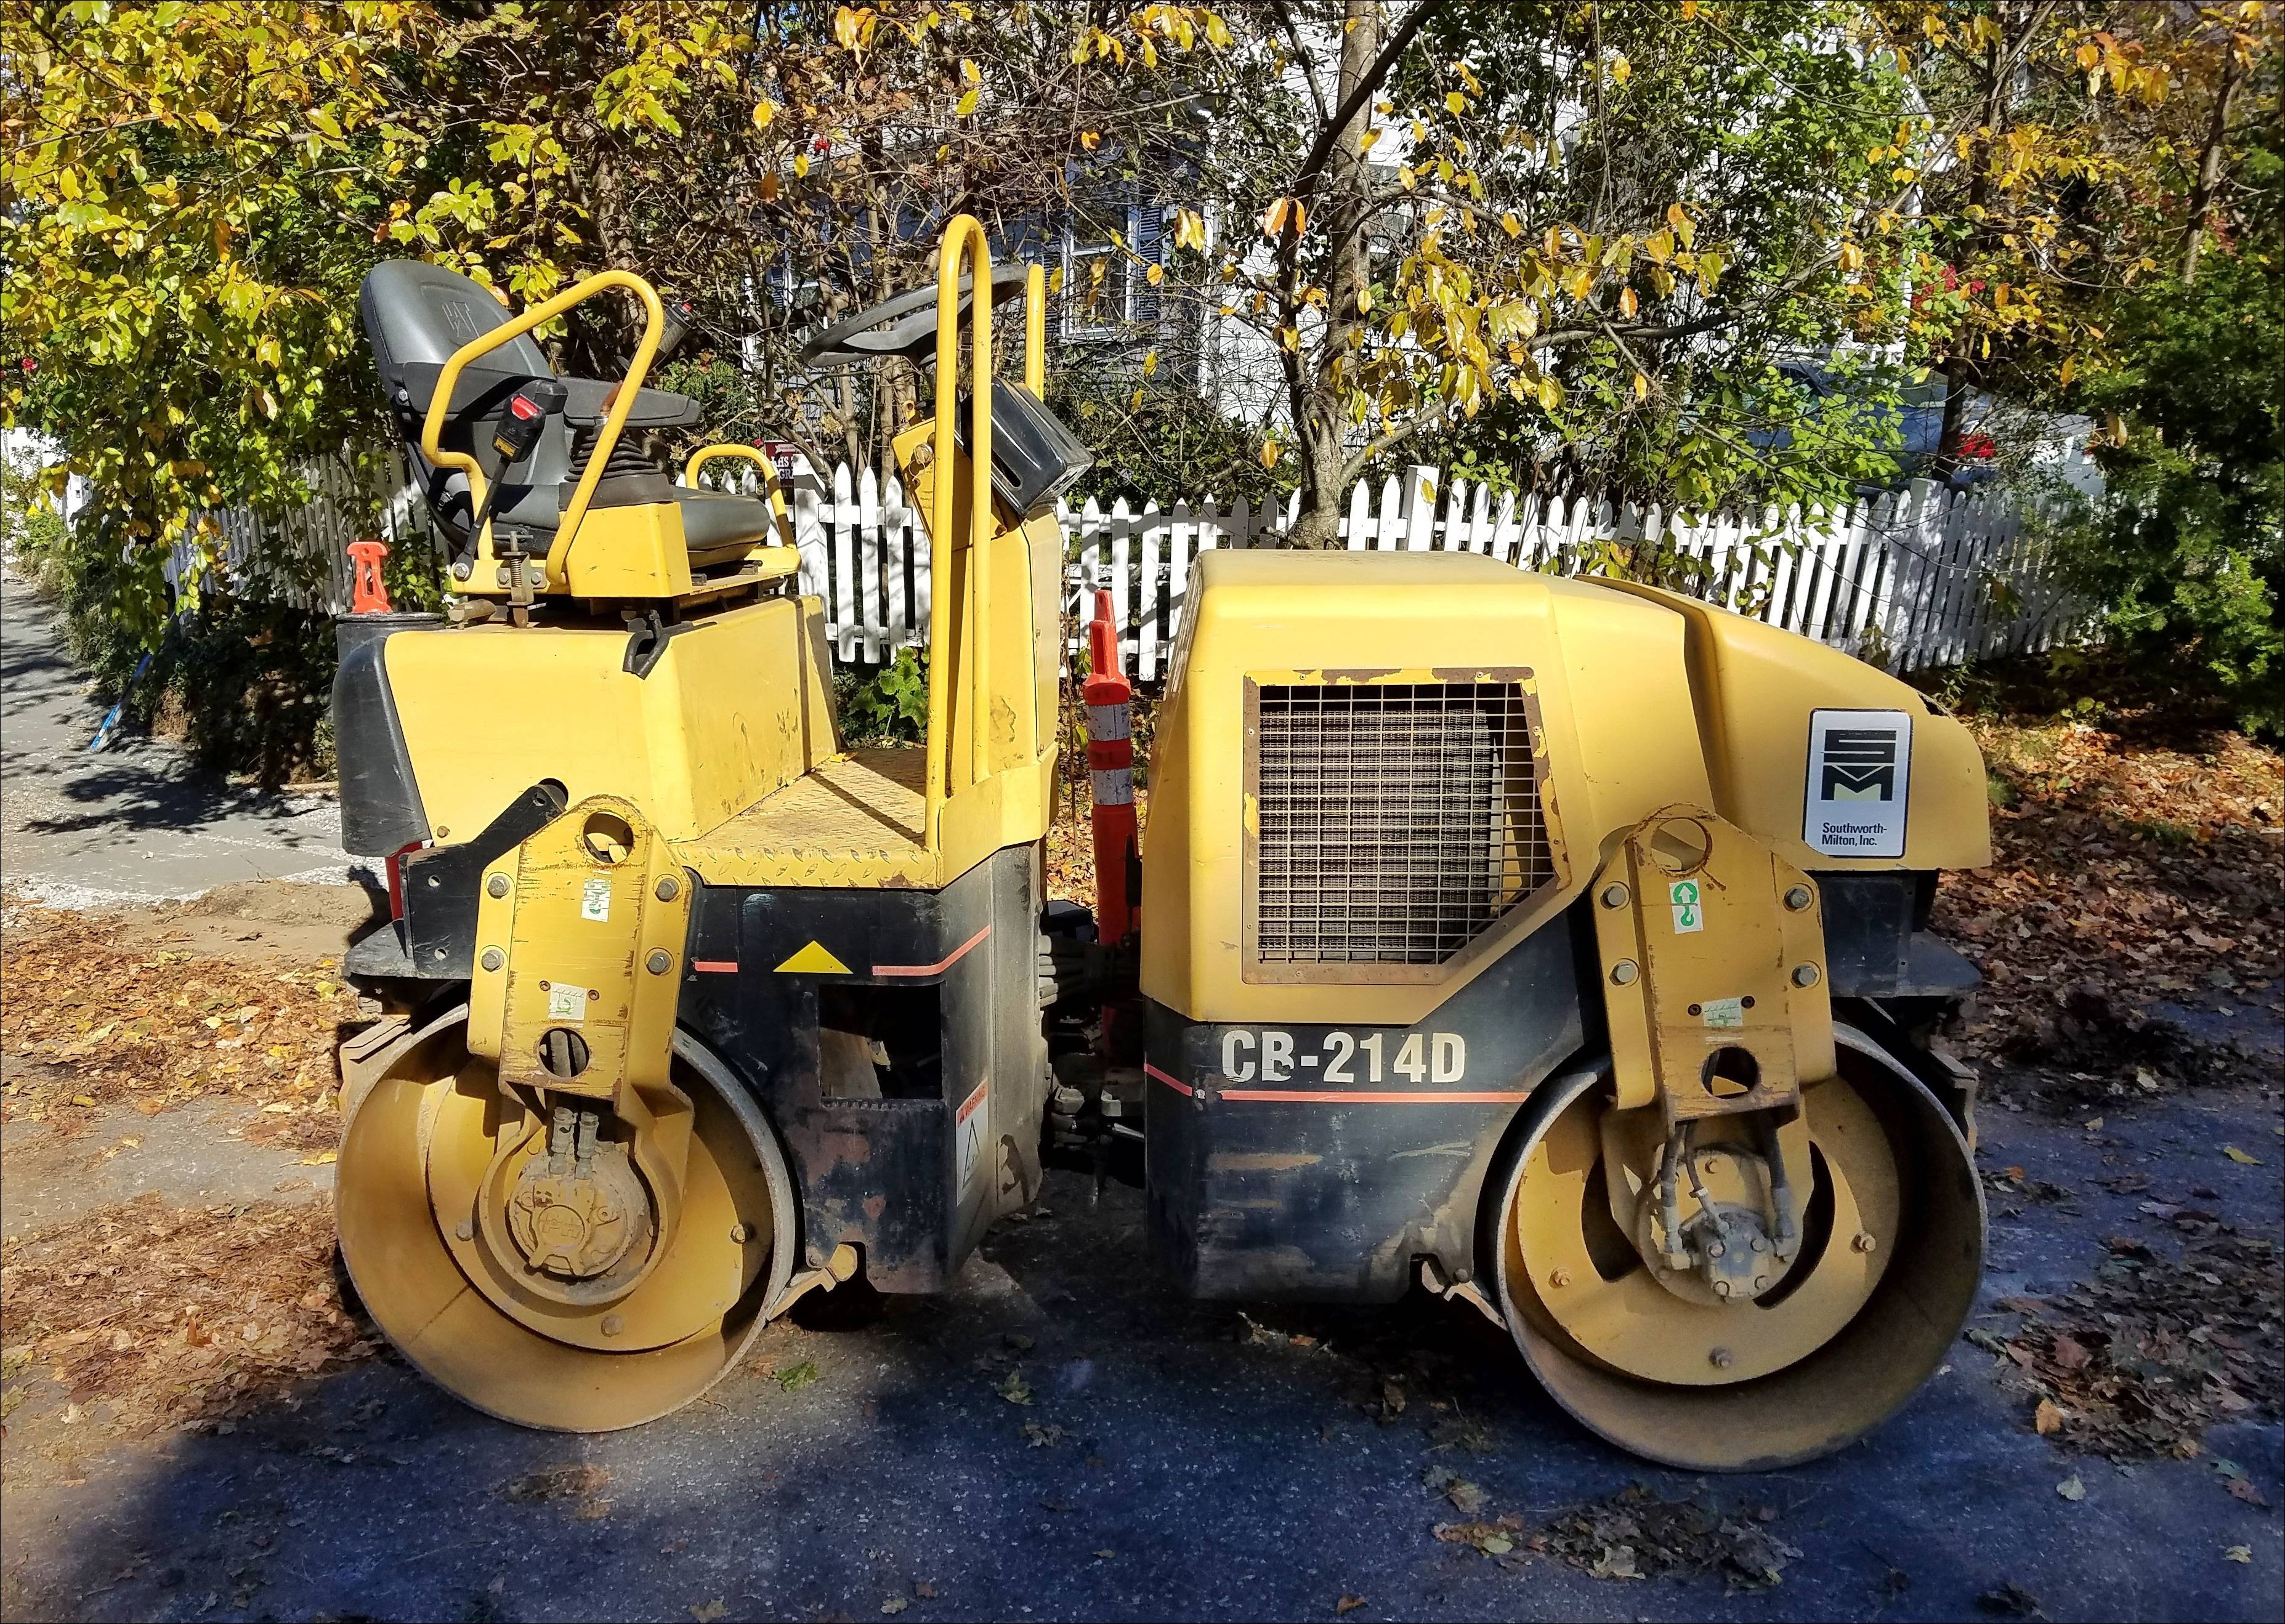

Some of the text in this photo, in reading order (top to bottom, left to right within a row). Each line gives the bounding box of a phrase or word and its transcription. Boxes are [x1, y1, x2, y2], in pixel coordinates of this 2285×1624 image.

[1822, 822, 1887, 833] Southworth-
[1821, 834, 1877, 847] Milton, Inc.
[1222, 1030, 1465, 1083] CB-214D
[965, 1086, 985, 1117] WARNING
